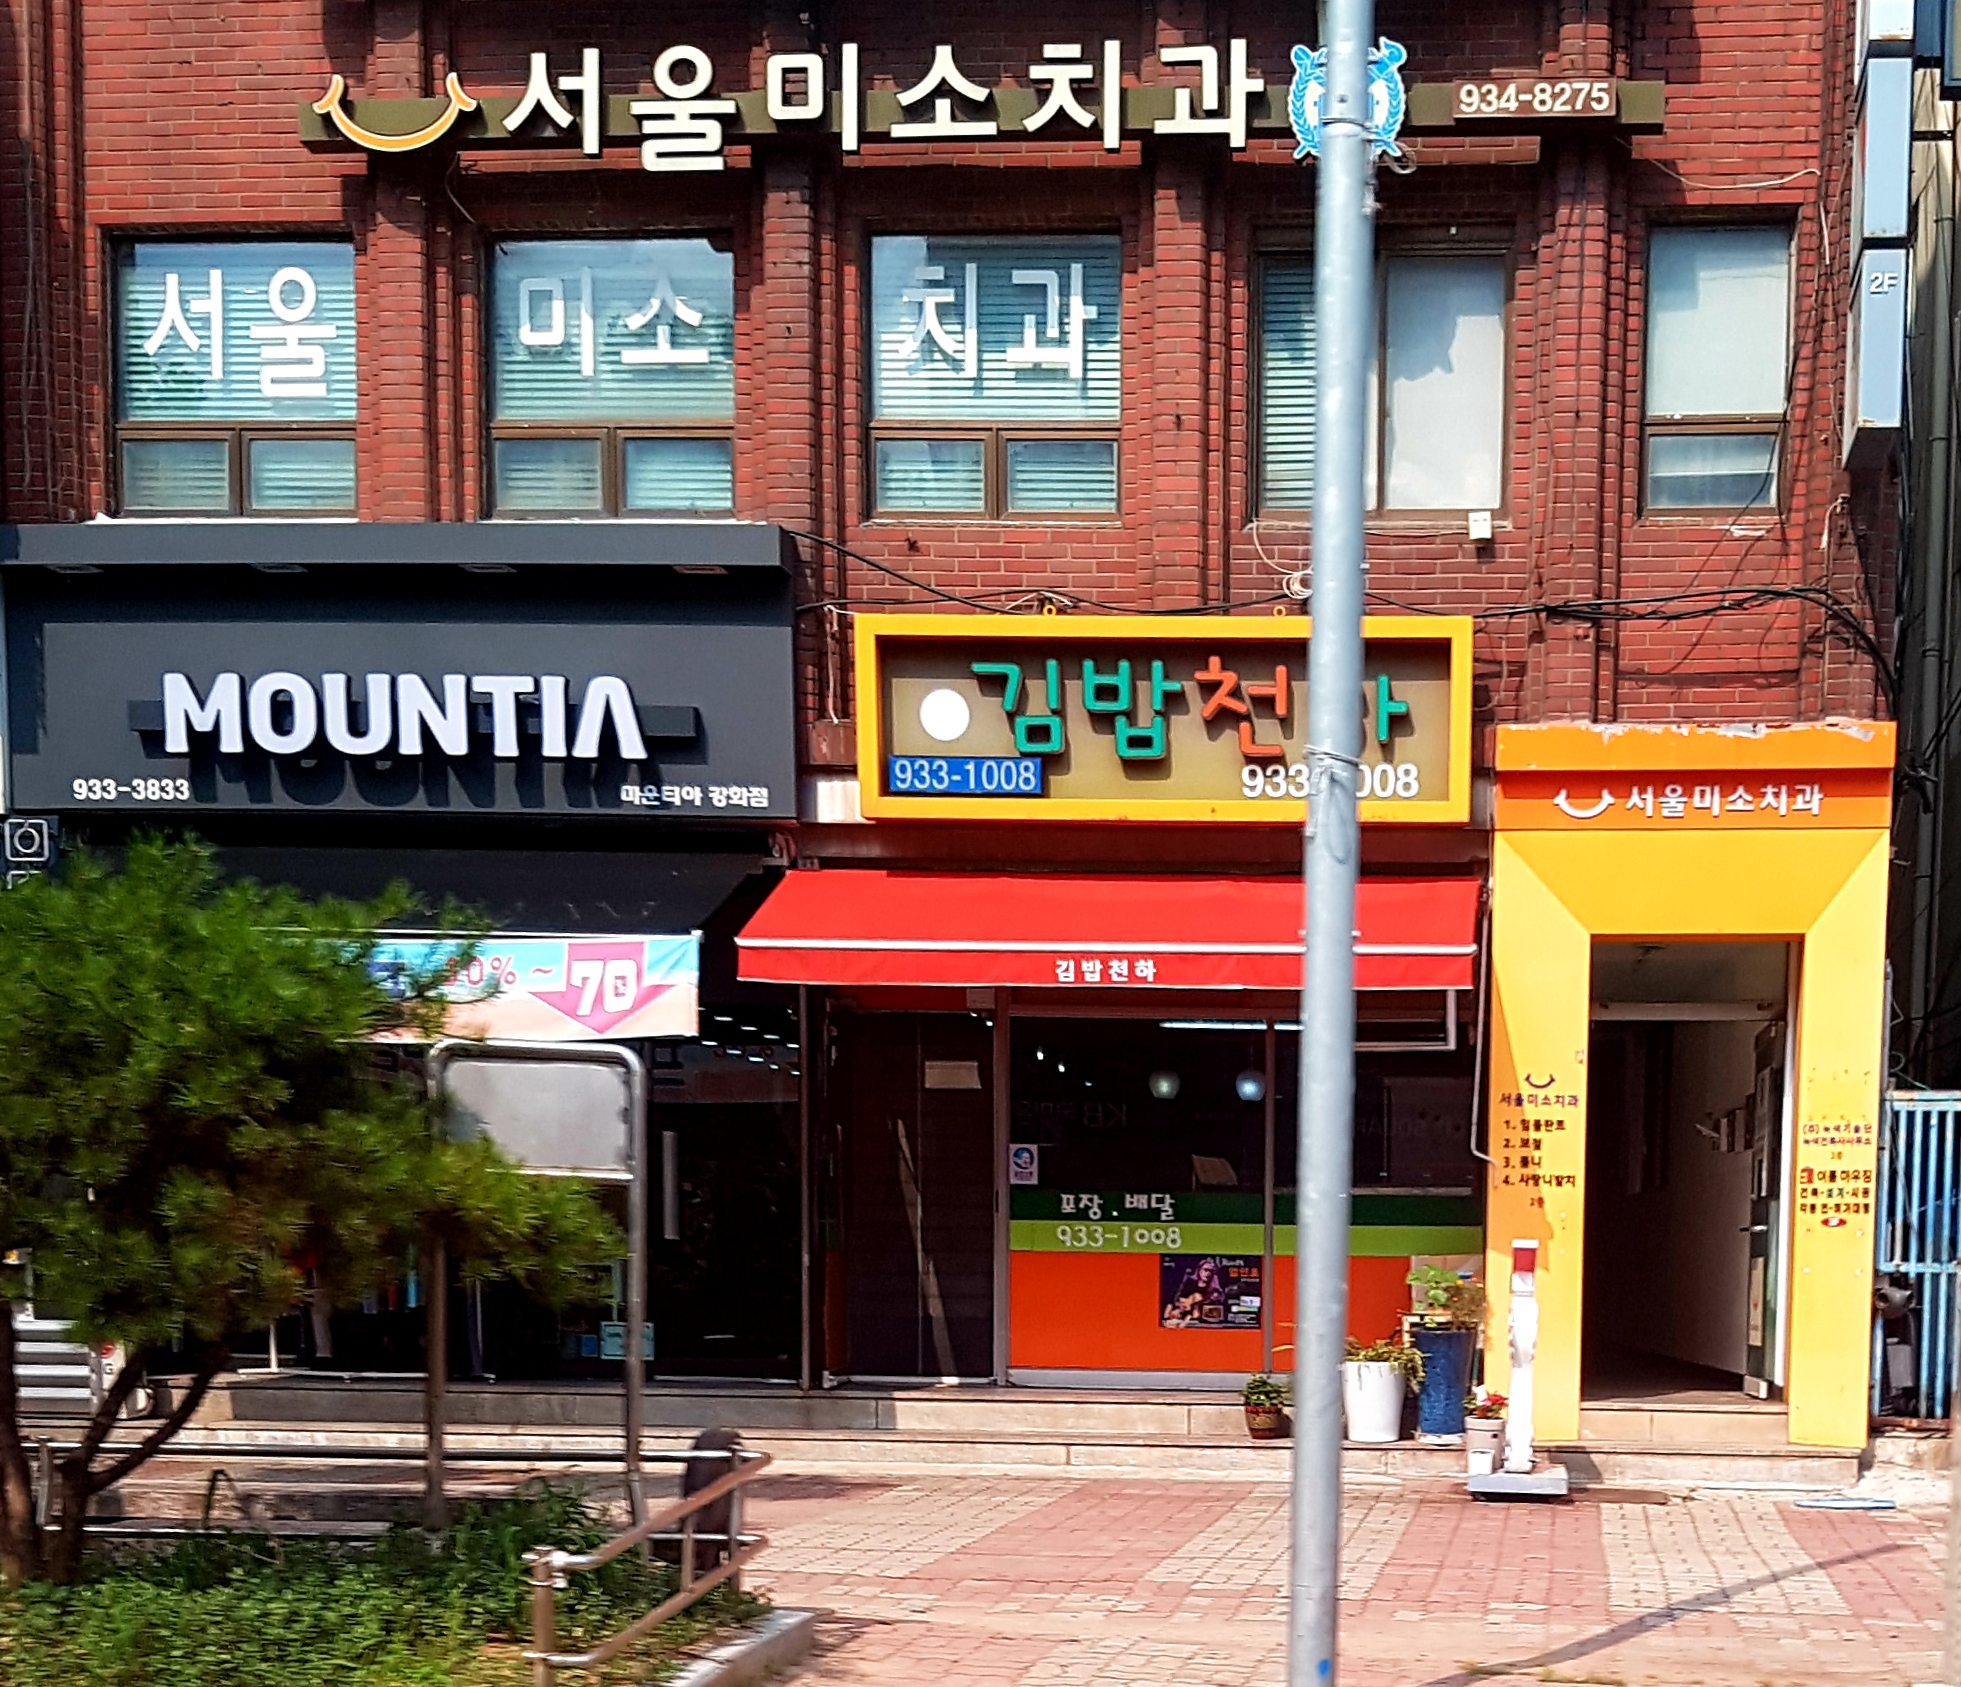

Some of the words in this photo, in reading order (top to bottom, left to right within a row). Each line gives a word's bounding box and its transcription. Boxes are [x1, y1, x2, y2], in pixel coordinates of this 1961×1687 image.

[503, 39, 1264, 171] 서울미소치과
[1459, 83, 1610, 113] 934-8275
[1869, 274, 1897, 293] 2F
[143, 265, 337, 397] 서울
[518, 266, 709, 376] 미소
[900, 262, 1097, 379] 치과
[161, 671, 647, 760] MOUNTIA
[970, 655, 1410, 760] 김밥천
[73, 779, 189, 801] 933-3833
[894, 760, 1036, 793] 933-1008
[1241, 764, 1420, 798] 933008
[620, 785, 702, 805] 마운티아
[708, 785, 769, 808] 강화점
[1625, 784, 1824, 818] 서울미소치과
[1055, 959, 1157, 984] 김밥천하
[1060, 1193, 1102, 1218] 포장
[1125, 1193, 1176, 1220] 배달
[1057, 1225, 1183, 1250] 933-1008
